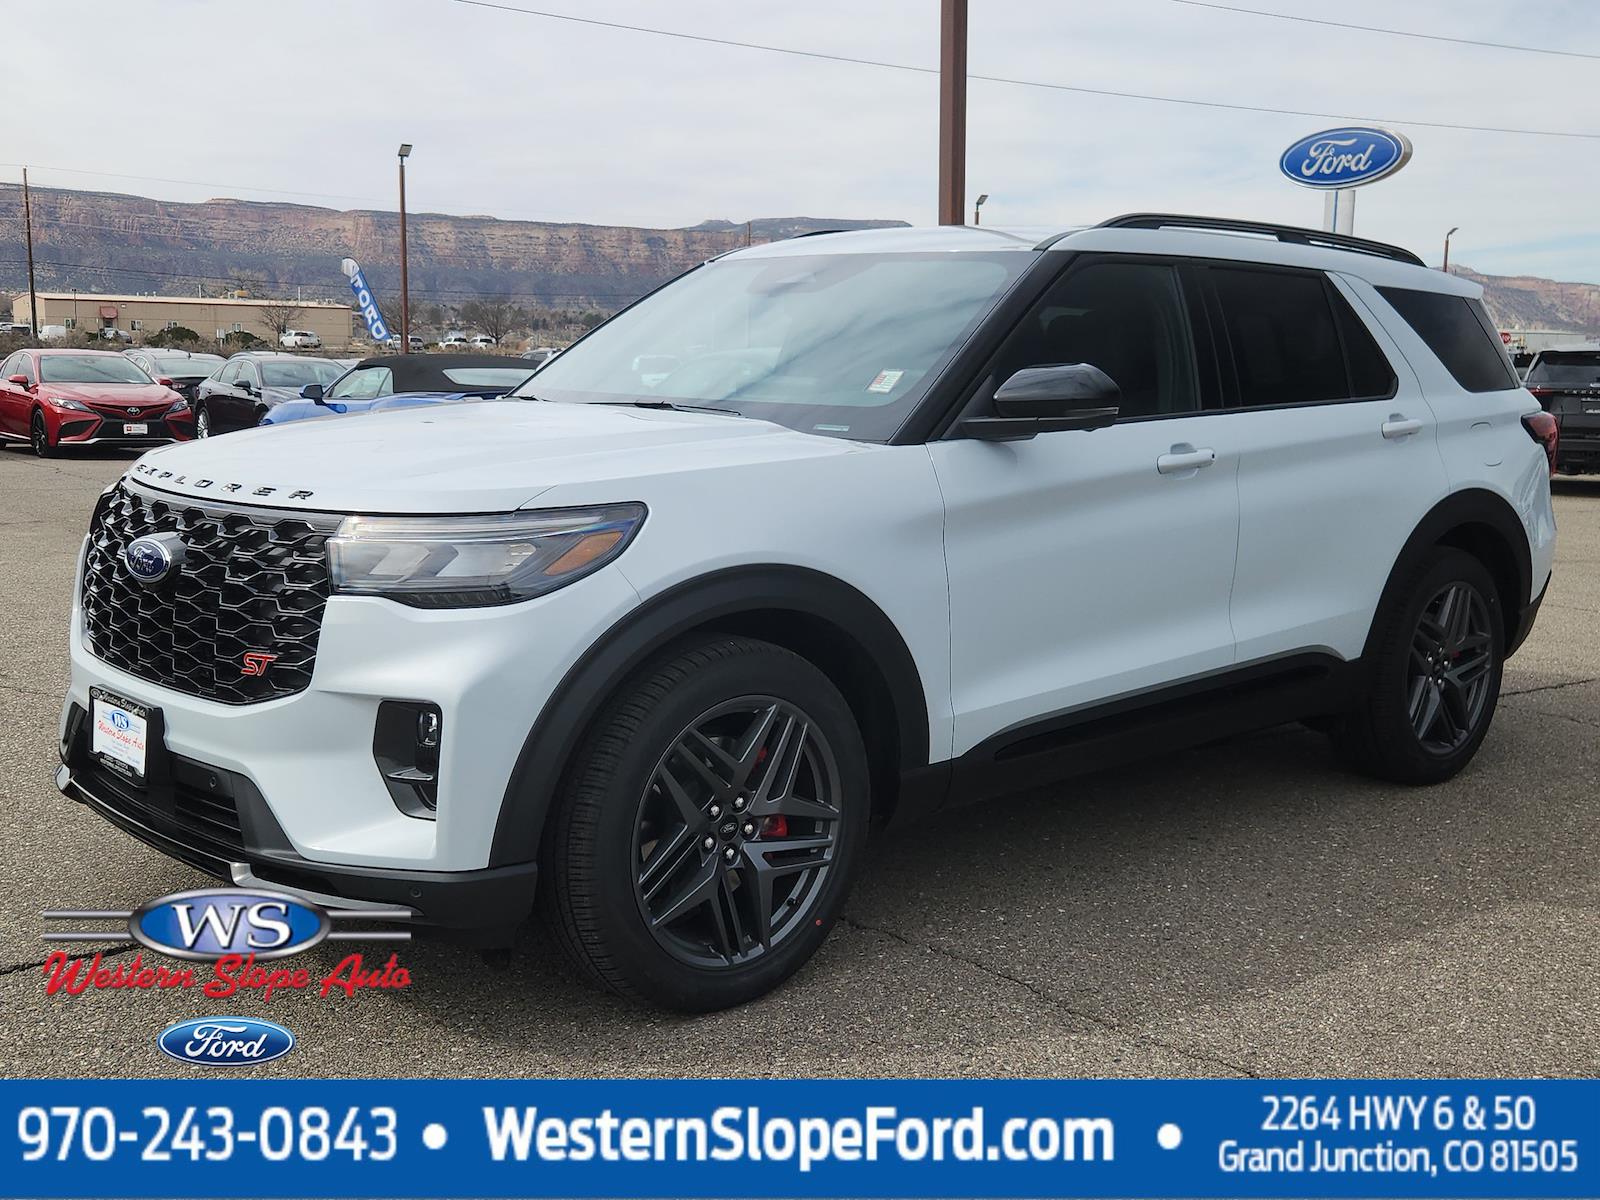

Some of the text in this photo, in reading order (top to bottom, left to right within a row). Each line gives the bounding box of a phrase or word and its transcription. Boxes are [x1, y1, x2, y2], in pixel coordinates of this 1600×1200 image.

[1301, 138, 1376, 176] Ford
[350, 274, 387, 339] FORD
[136, 463, 315, 501] EXPLORER
[130, 545, 156, 573] Ford
[240, 652, 279, 676] ST
[113, 712, 129, 729] WS
